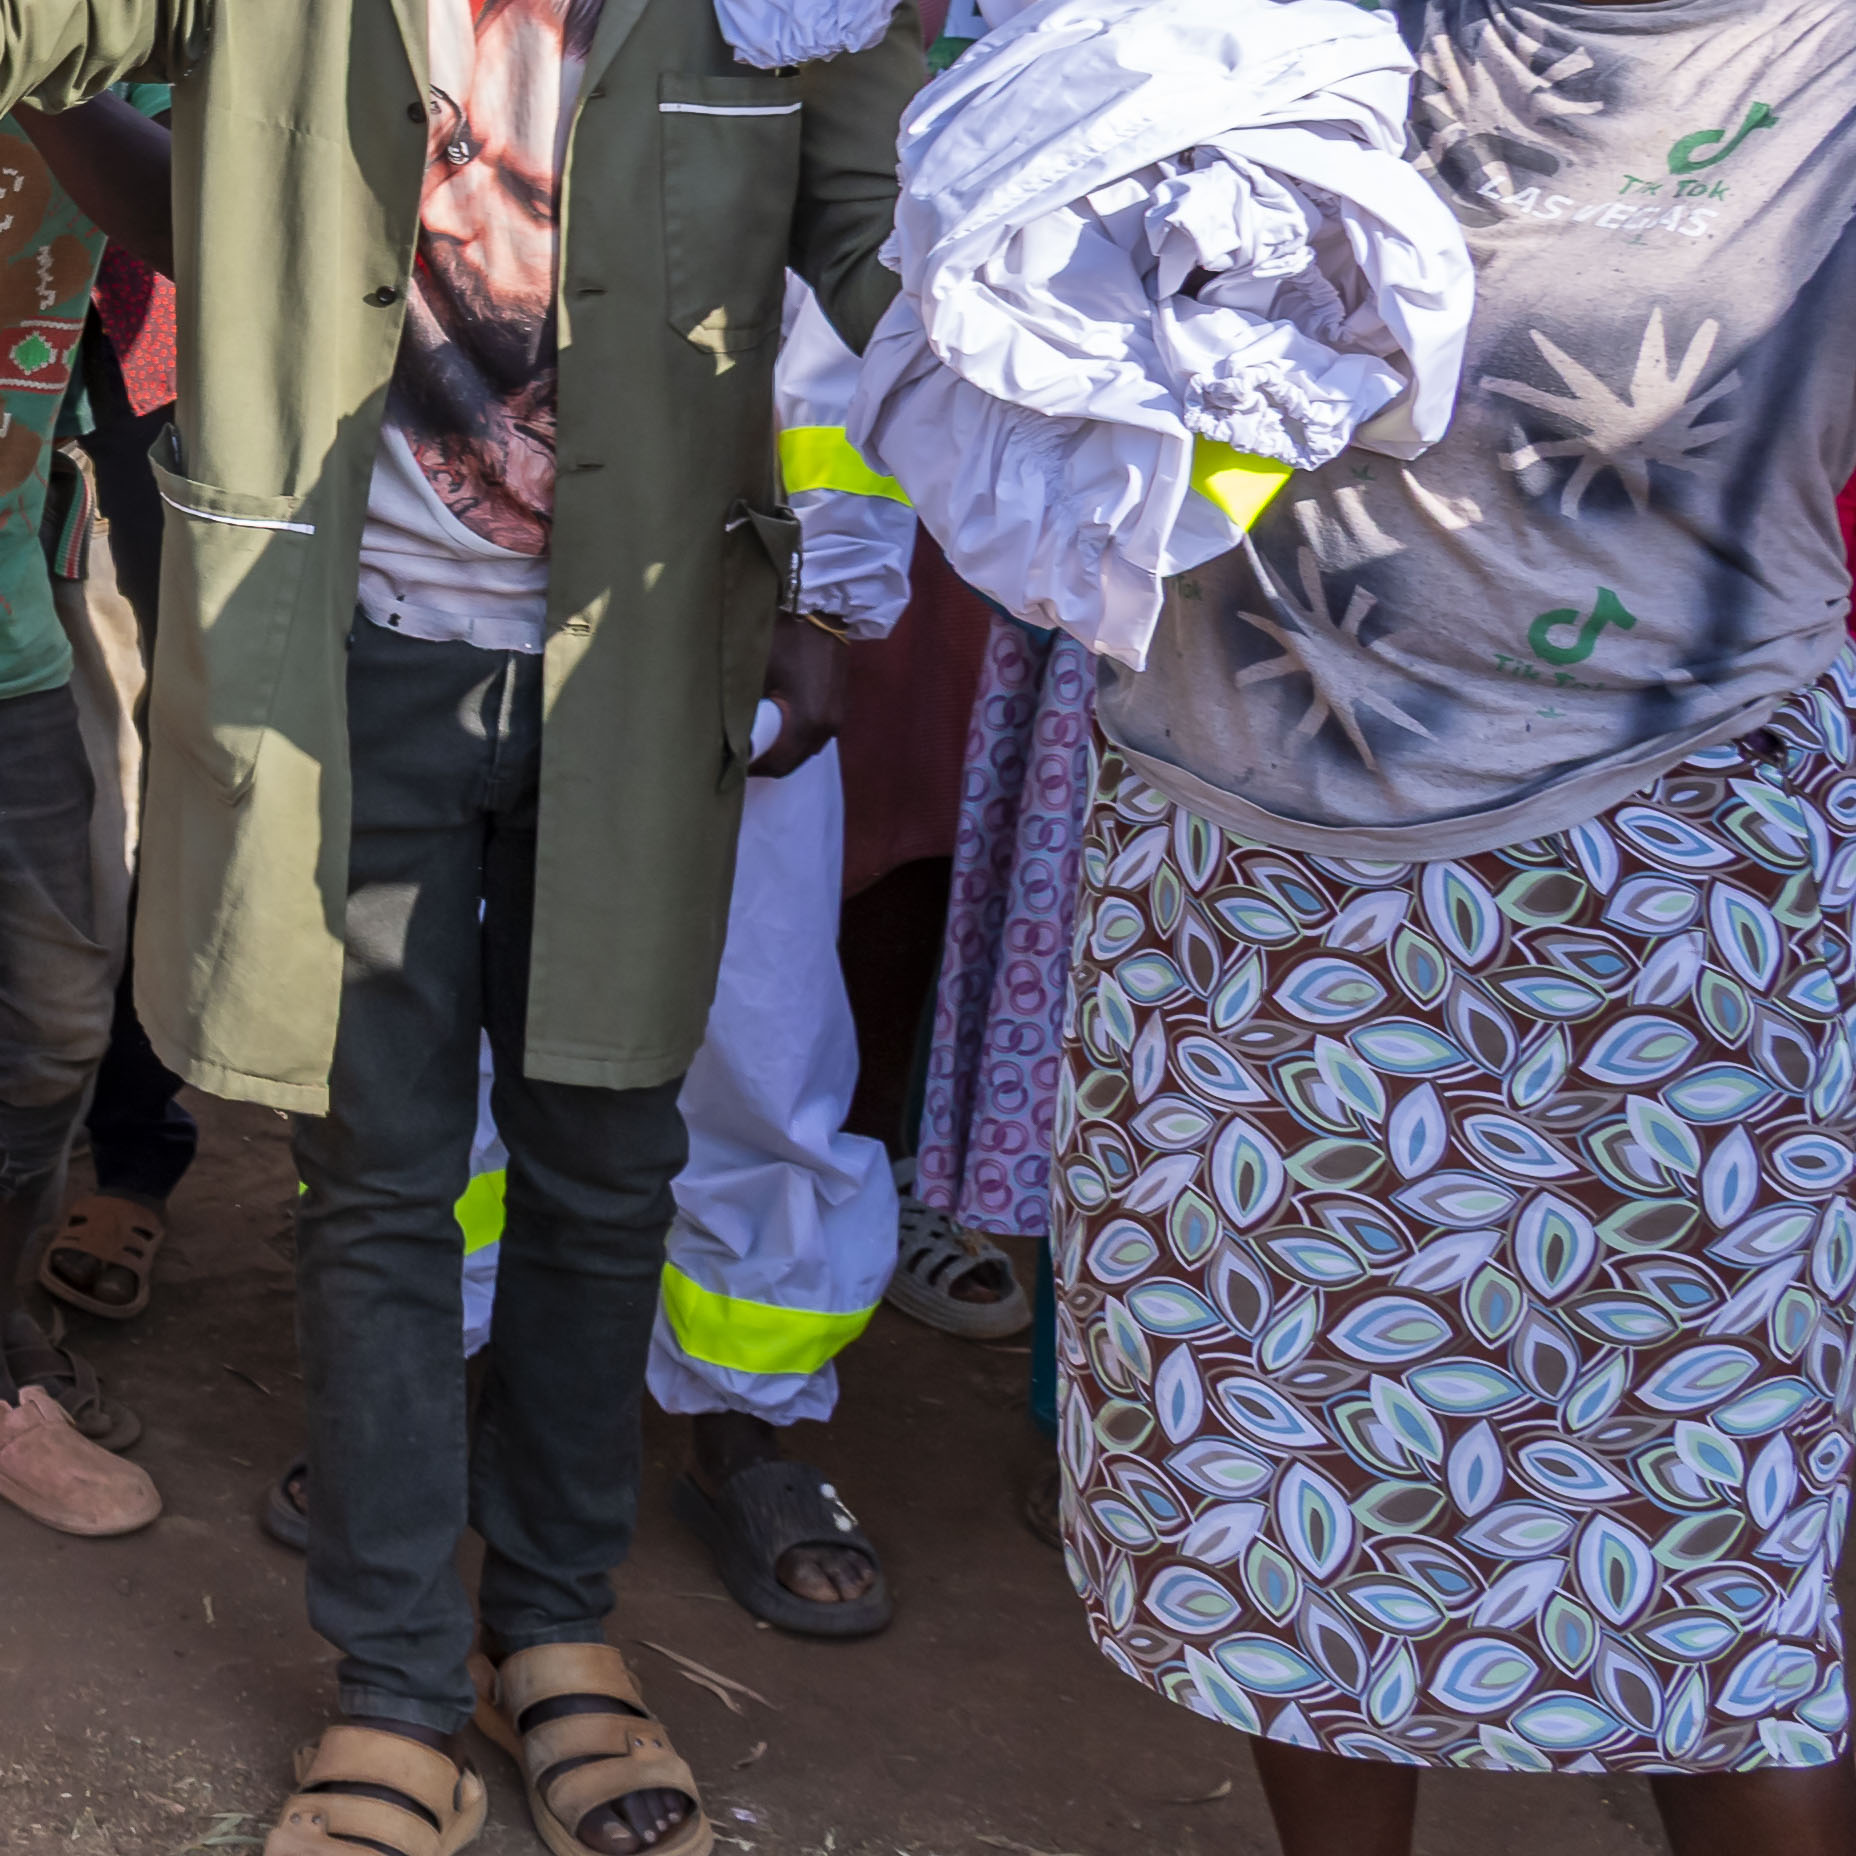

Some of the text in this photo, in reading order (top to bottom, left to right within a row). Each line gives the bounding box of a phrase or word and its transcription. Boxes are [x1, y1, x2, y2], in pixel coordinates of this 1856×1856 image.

[1476, 175, 1720, 238] LAS VEGAS
[1673, 179, 1731, 201] Tok
